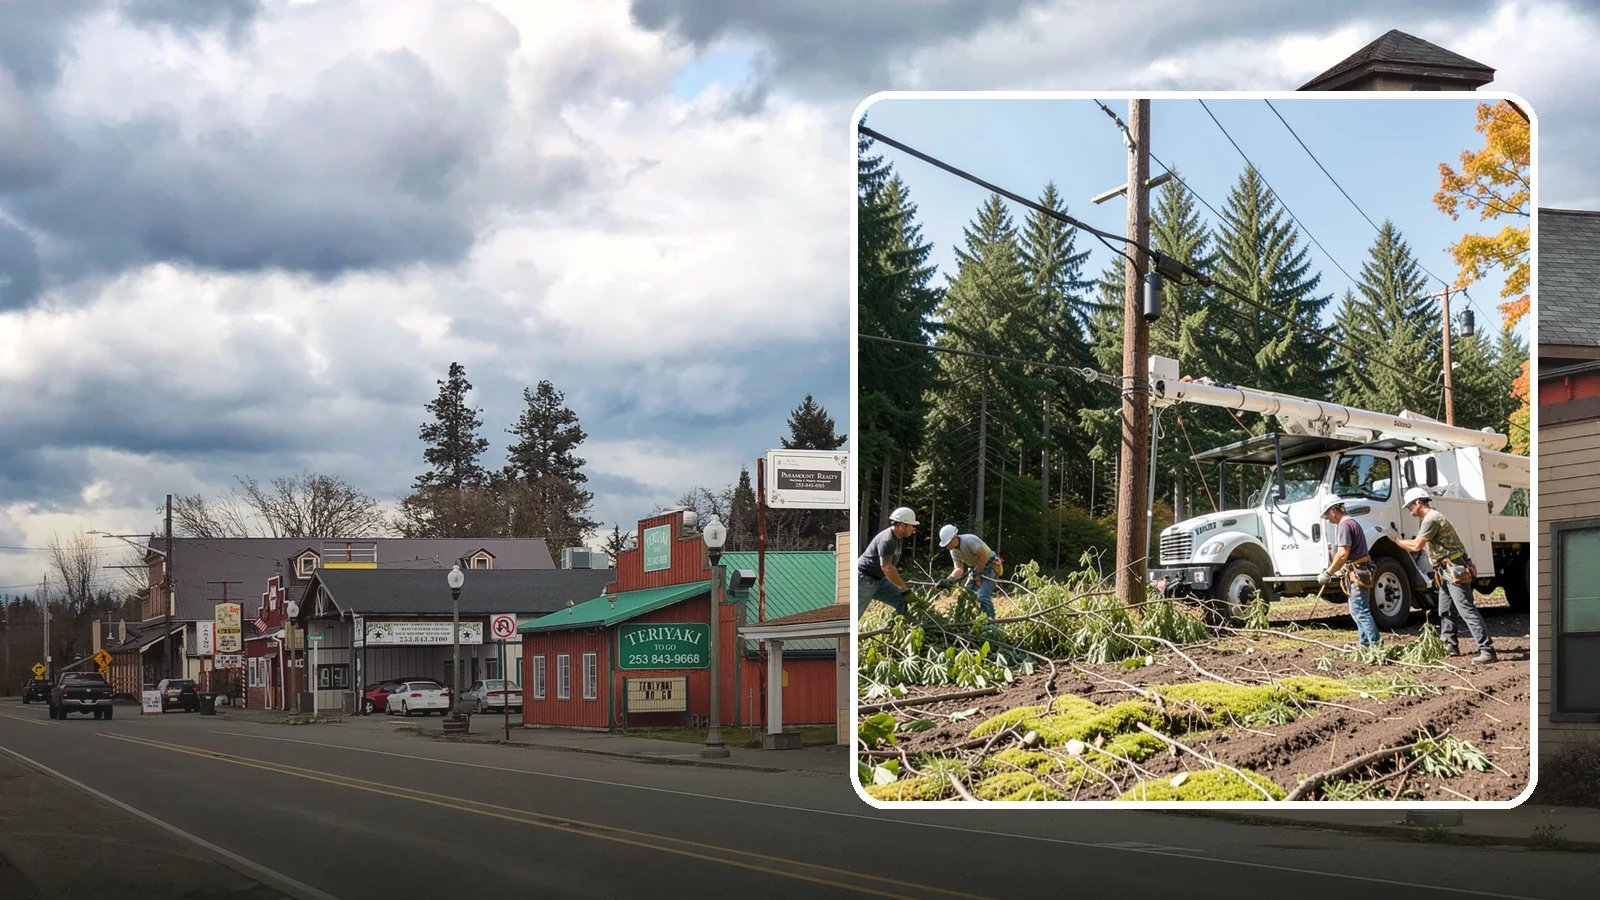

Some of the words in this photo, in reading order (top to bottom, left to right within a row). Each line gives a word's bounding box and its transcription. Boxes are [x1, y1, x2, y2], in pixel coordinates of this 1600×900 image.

[625, 627, 702, 646] TERIYAKI
[629, 654, 648, 664] 253
[651, 654, 700, 664] 843-9668
